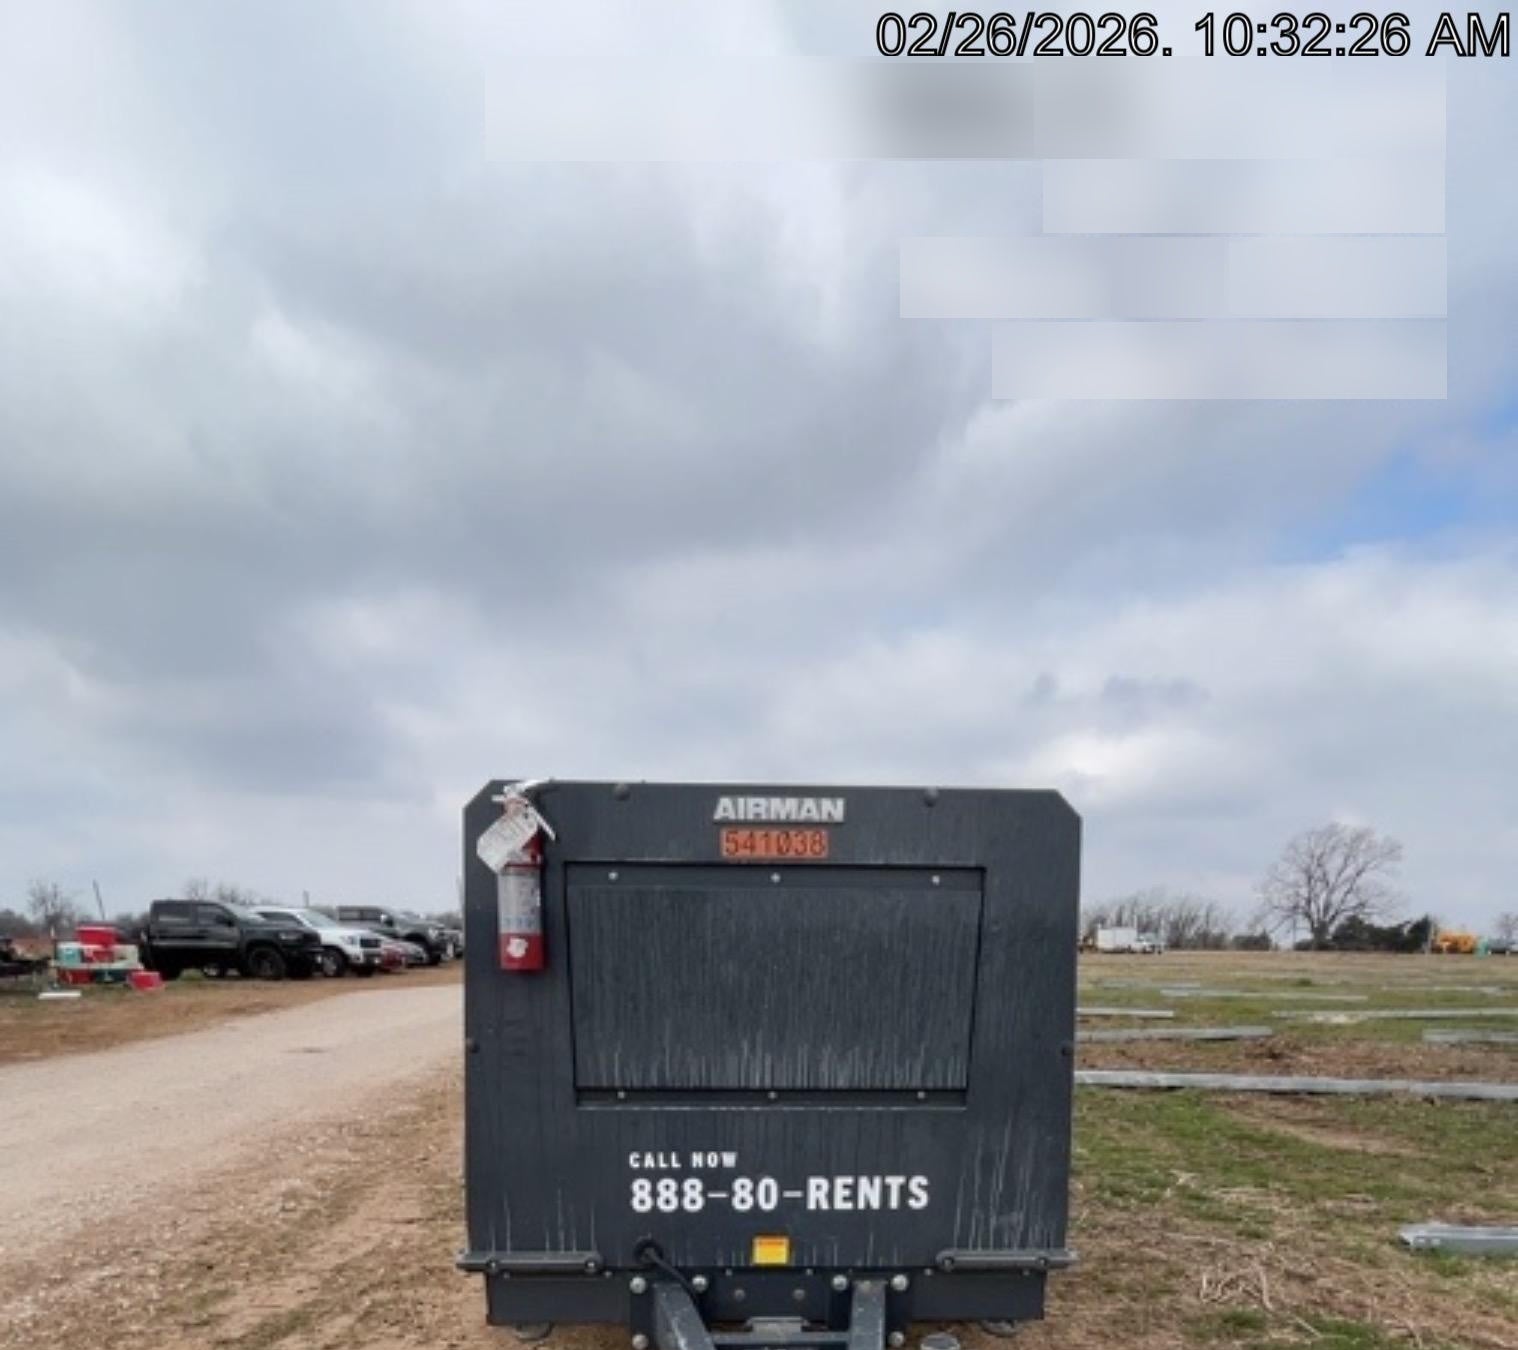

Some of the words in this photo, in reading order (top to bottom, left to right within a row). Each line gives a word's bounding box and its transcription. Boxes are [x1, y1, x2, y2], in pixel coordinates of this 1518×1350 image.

[713, 797, 845, 822] AIRMAN
[724, 830, 825, 856] 541038
[629, 1152, 682, 1168] CALL
[692, 1152, 738, 1168] NOW
[630, 1175, 930, 1213] 888-80-RENTS
